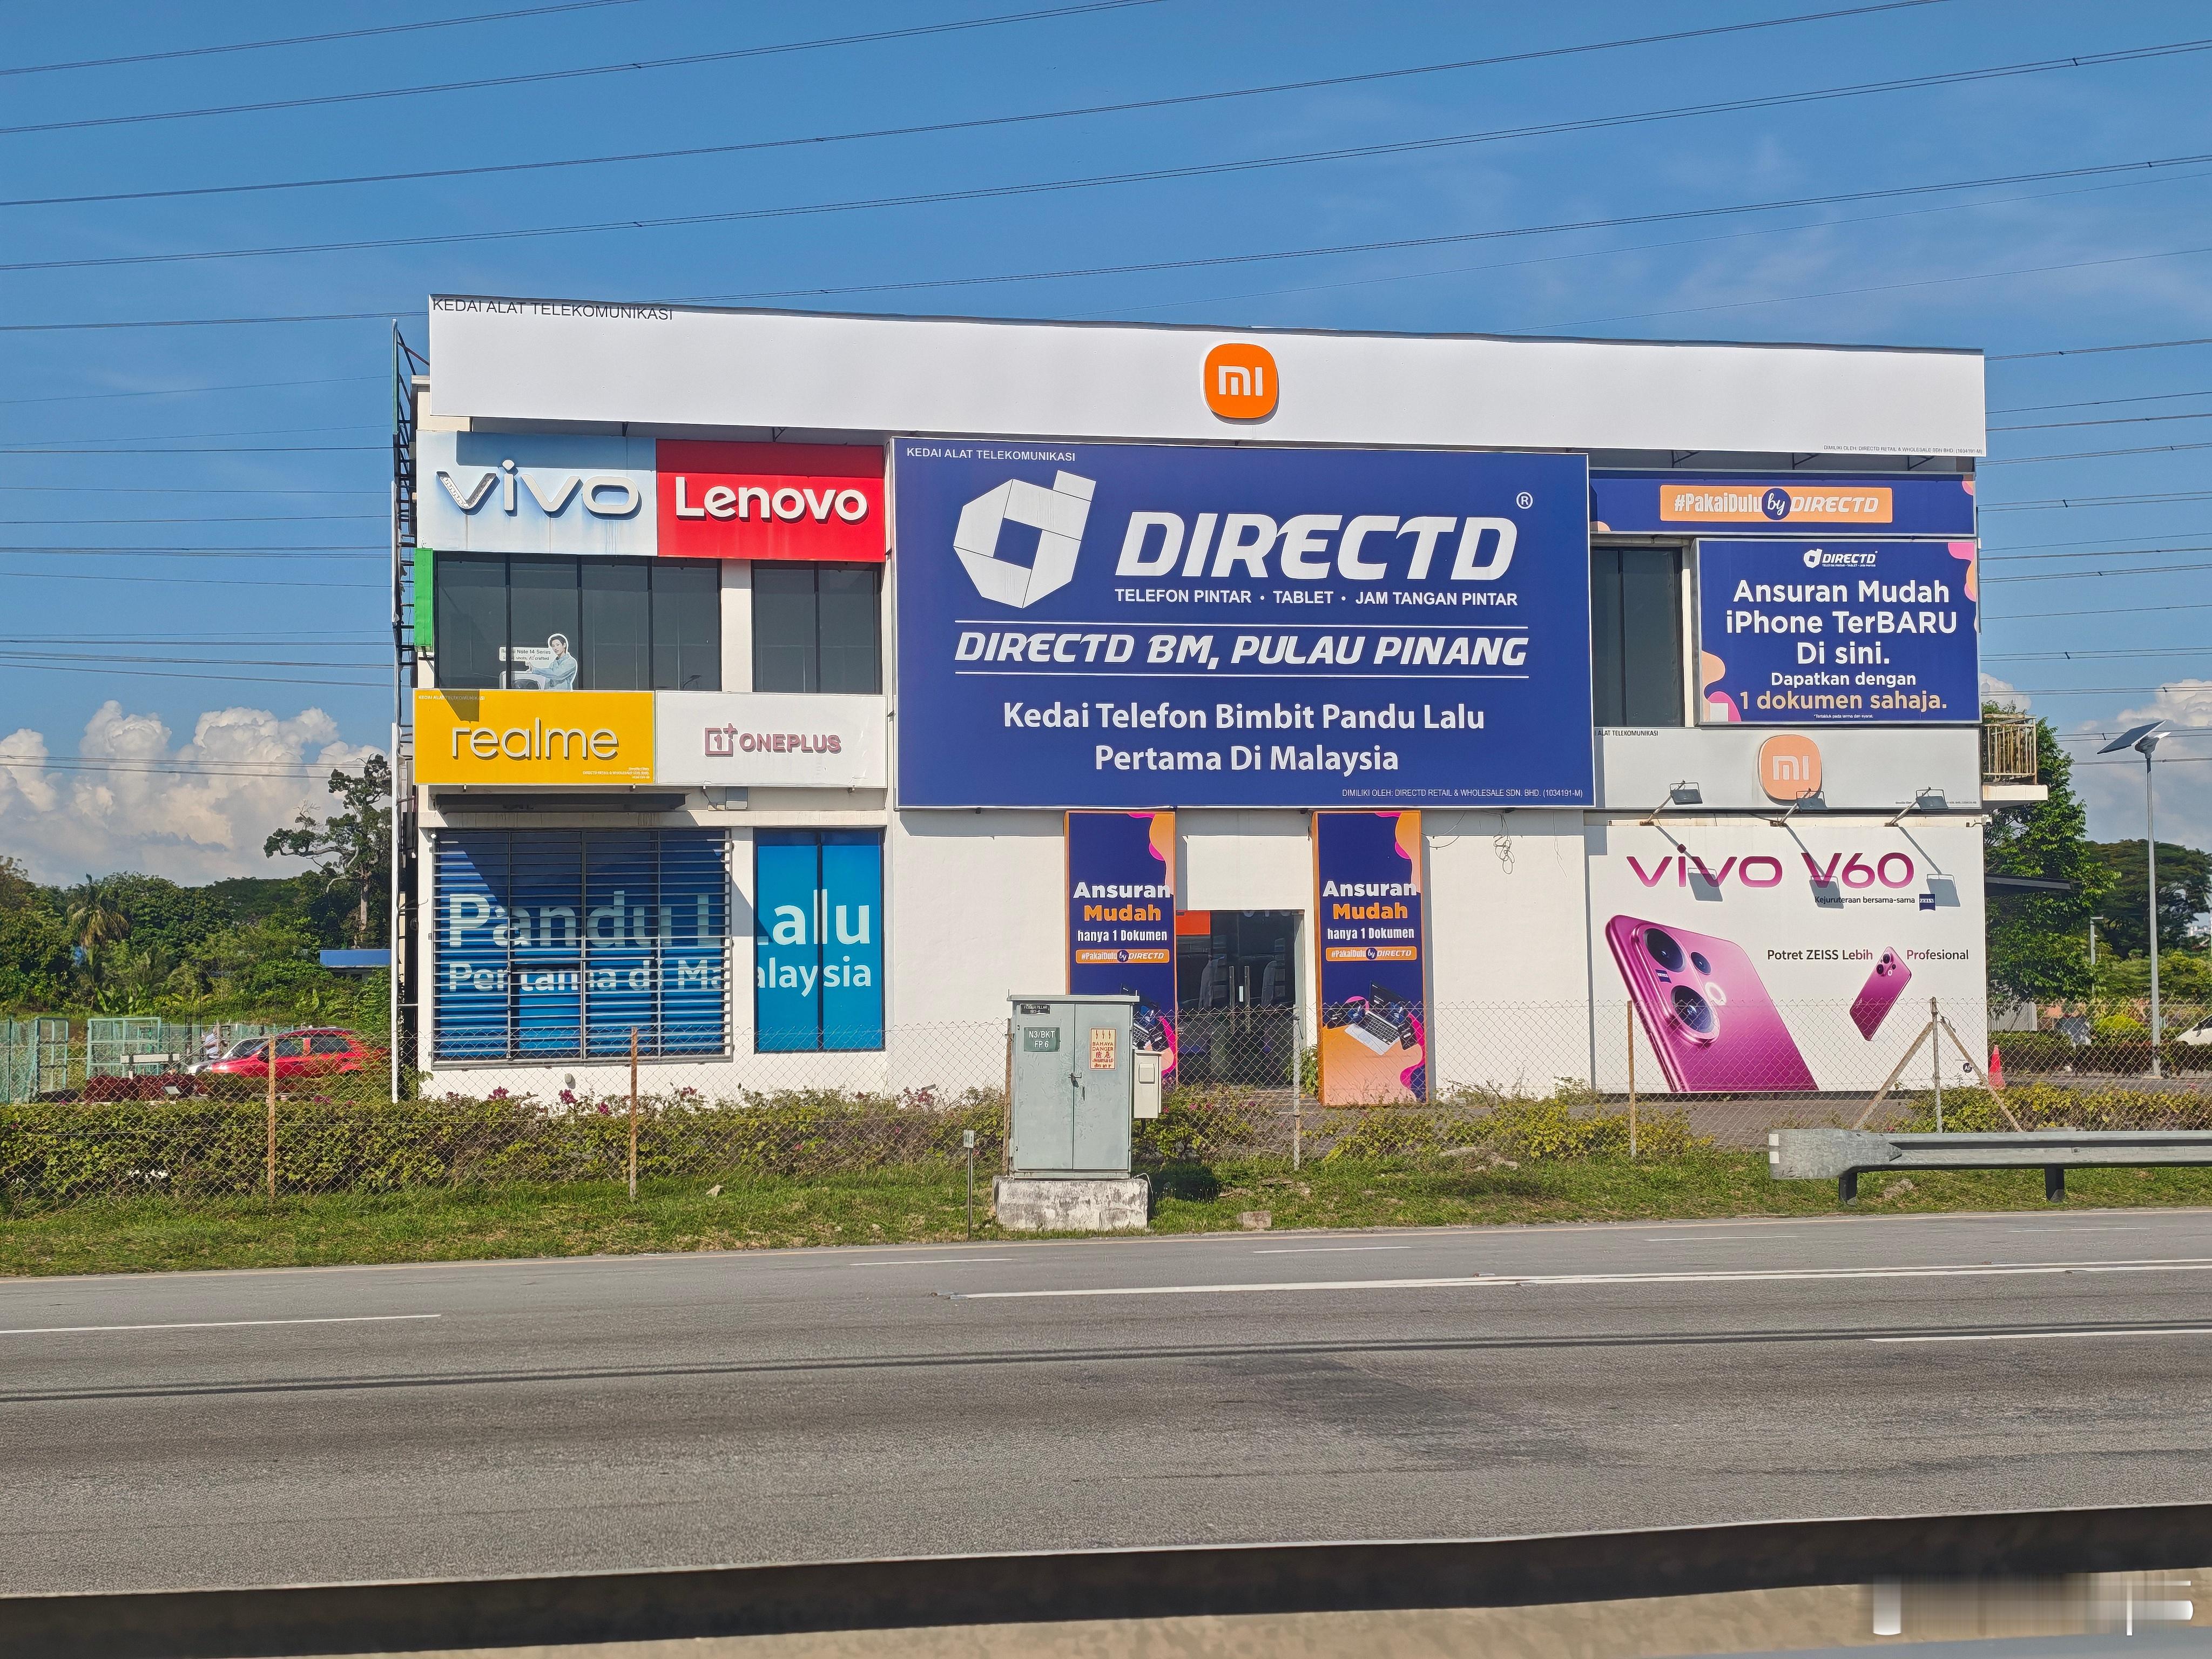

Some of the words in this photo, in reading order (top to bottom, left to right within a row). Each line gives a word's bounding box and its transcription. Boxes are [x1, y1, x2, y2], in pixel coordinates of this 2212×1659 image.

[433, 298, 481, 312] KEDAI
[487, 301, 525, 314] ALAT
[531, 302, 673, 320] TELEKOMUNIKASI
[907, 448, 941, 457] KEDAI
[945, 449, 973, 458] ALAT
[976, 450, 1075, 461] TELEKOMUNIKASI
[436, 459, 639, 514] vivo
[676, 476, 868, 521] Lenovo
[1674, 493, 1762, 512] #PakaiDulu
[1767, 493, 1785, 516] by
[1790, 496, 1879, 512] DIRECTD
[1115, 511, 1518, 581] DIRECTD
[1822, 554, 1876, 563] DIRECTD
[1115, 589, 1189, 603] TELEFON
[1194, 590, 1251, 603] PINTAR
[1273, 590, 1333, 604] TABLET
[1355, 591, 1388, 604] JAM
[1393, 592, 1457, 605] TANGAN
[1462, 592, 1518, 606] PINTAR
[1733, 579, 1847, 602] Ansuran
[1858, 579, 1949, 603] Mudah
[1727, 610, 1823, 633] iPhone
[1832, 611, 1957, 634] TerBARU
[954, 631, 1135, 663] DIRECTD
[1147, 634, 1218, 670] BM,
[1231, 636, 1365, 665] PULAU
[1373, 637, 1529, 666] PINANG
[1797, 641, 1825, 664] Di
[1835, 641, 1890, 664] sini.
[1771, 672, 1850, 688] Dapatkan
[1854, 672, 1916, 689] dengan
[1740, 691, 1748, 709] 1
[1757, 690, 1862, 710] dokumen
[1870, 690, 1947, 712] sahaja.
[1003, 702, 1089, 729] Kedai
[1095, 702, 1206, 729] Telefon
[1216, 703, 1314, 729] Bimbit
[1323, 704, 1415, 729] Pandu
[1424, 704, 1485, 729] Lalu
[451, 718, 619, 761] realme
[739, 733, 842, 754] ONEPLUS
[1095, 745, 1222, 771] Pertama
[1231, 745, 1260, 771] Di
[1270, 745, 1399, 777] Malaysia
[1342, 789, 1370, 798] DIMILIKI
[1372, 790, 1393, 798] OLEH:
[1395, 790, 1426, 798] DIRECTD
[1428, 790, 1452, 798] RETAIL
[1454, 790, 1459, 798] &
[1460, 790, 1503, 798] WHOLESALE
[1506, 790, 1523, 798] SDN.
[1525, 790, 1541, 798] BHD.
[1543, 790, 1582, 799] (1034191-M)
[1626, 843, 1783, 888] vivo
[1801, 852, 1914, 888] V60
[1073, 882, 1170, 898] Ansuran
[1323, 880, 1417, 896] Ansuran
[1815, 896, 1861, 904] Kejuruteraan
[449, 891, 672, 948] Pandu
[1084, 904, 1161, 921] Mudah
[1333, 902, 1408, 919] Mudah
[1077, 930, 1109, 942] hanya
[1112, 930, 1117, 941] 1
[1121, 930, 1168, 941] Dokumen
[1327, 928, 1357, 940] hanya
[1361, 928, 1365, 939] 1
[1368, 928, 1414, 939] Dokumen
[1119, 951, 1127, 961] by
[1368, 949, 1375, 959] by
[1767, 949, 1804, 961] Potret
[1806, 949, 1839, 961] ZEISS
[1842, 949, 1873, 961] Lebih
[1906, 949, 1969, 961] Profesional
[1029, 1030, 1055, 1038] N3/BKT
